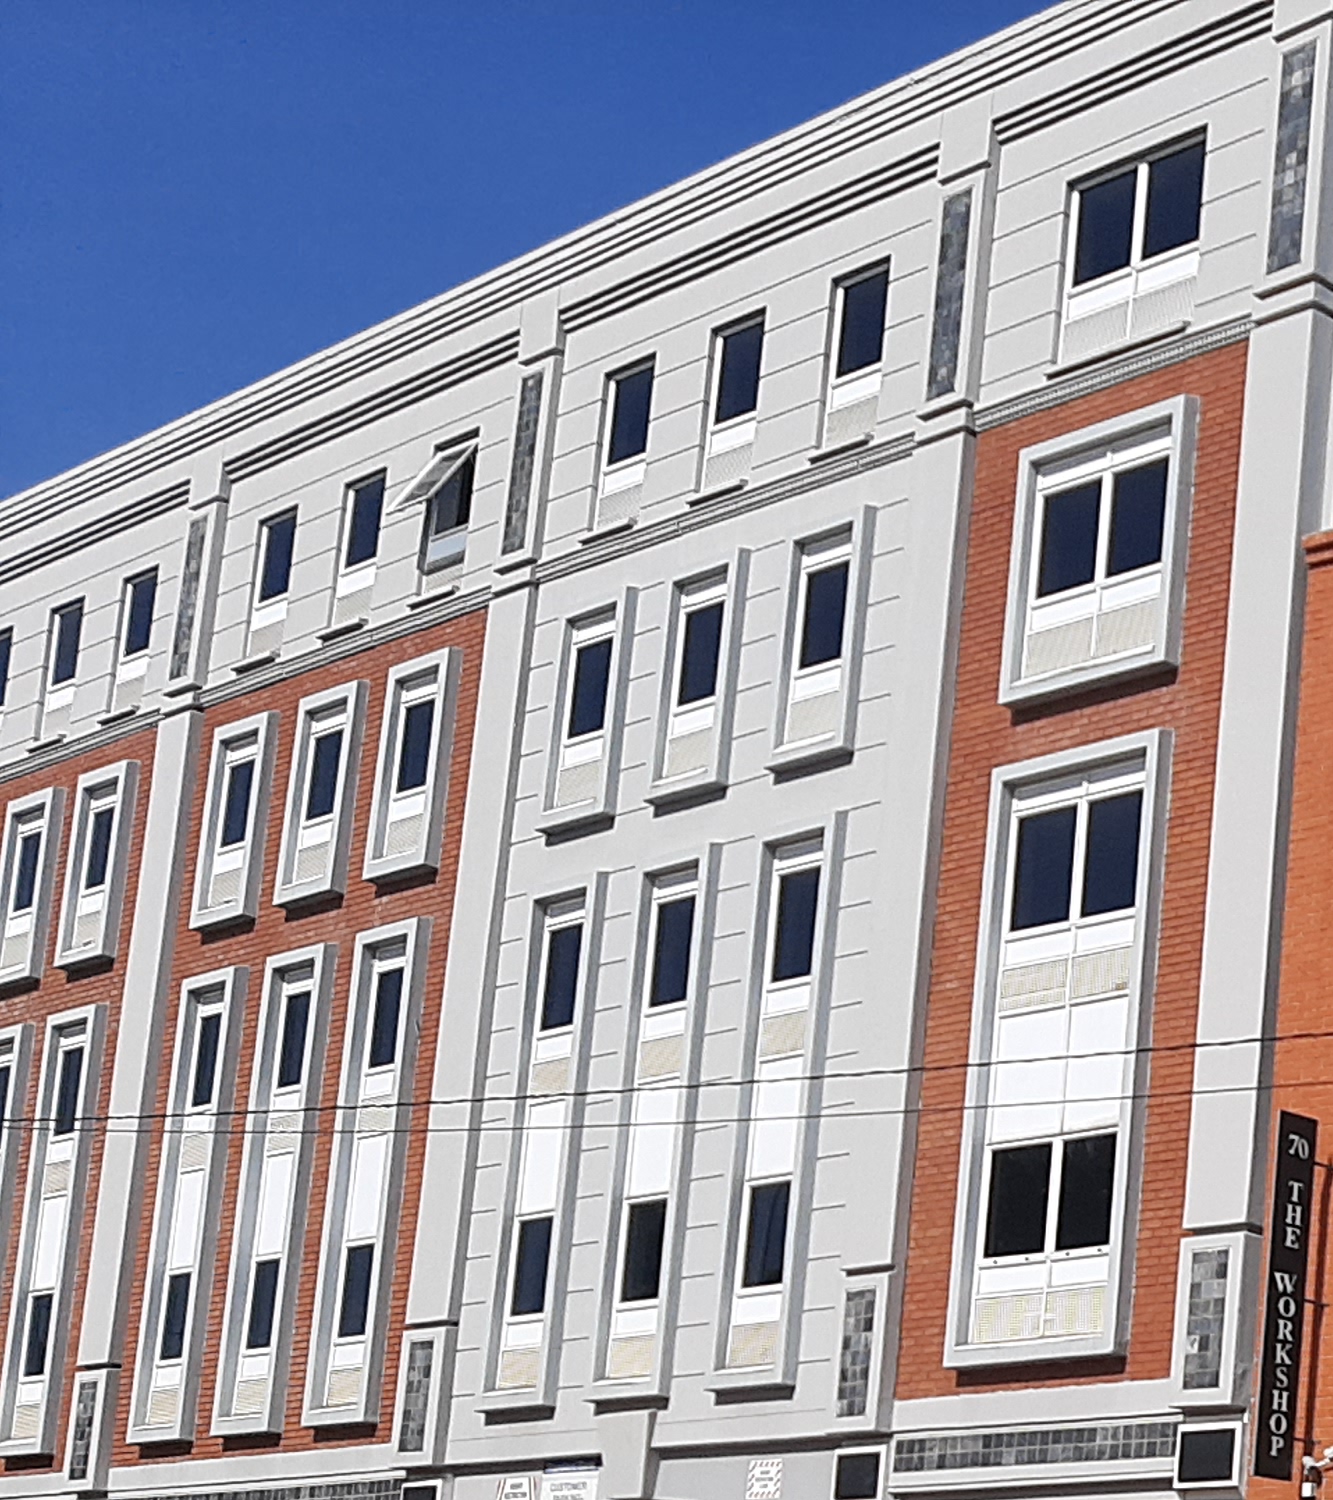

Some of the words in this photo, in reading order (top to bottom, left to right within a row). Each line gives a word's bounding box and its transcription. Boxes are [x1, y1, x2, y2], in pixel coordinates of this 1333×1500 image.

[1287, 1133, 1310, 1160] 70
[1284, 1180, 1304, 1250] THE
[1269, 1271, 1298, 1457] WORKSHOP
